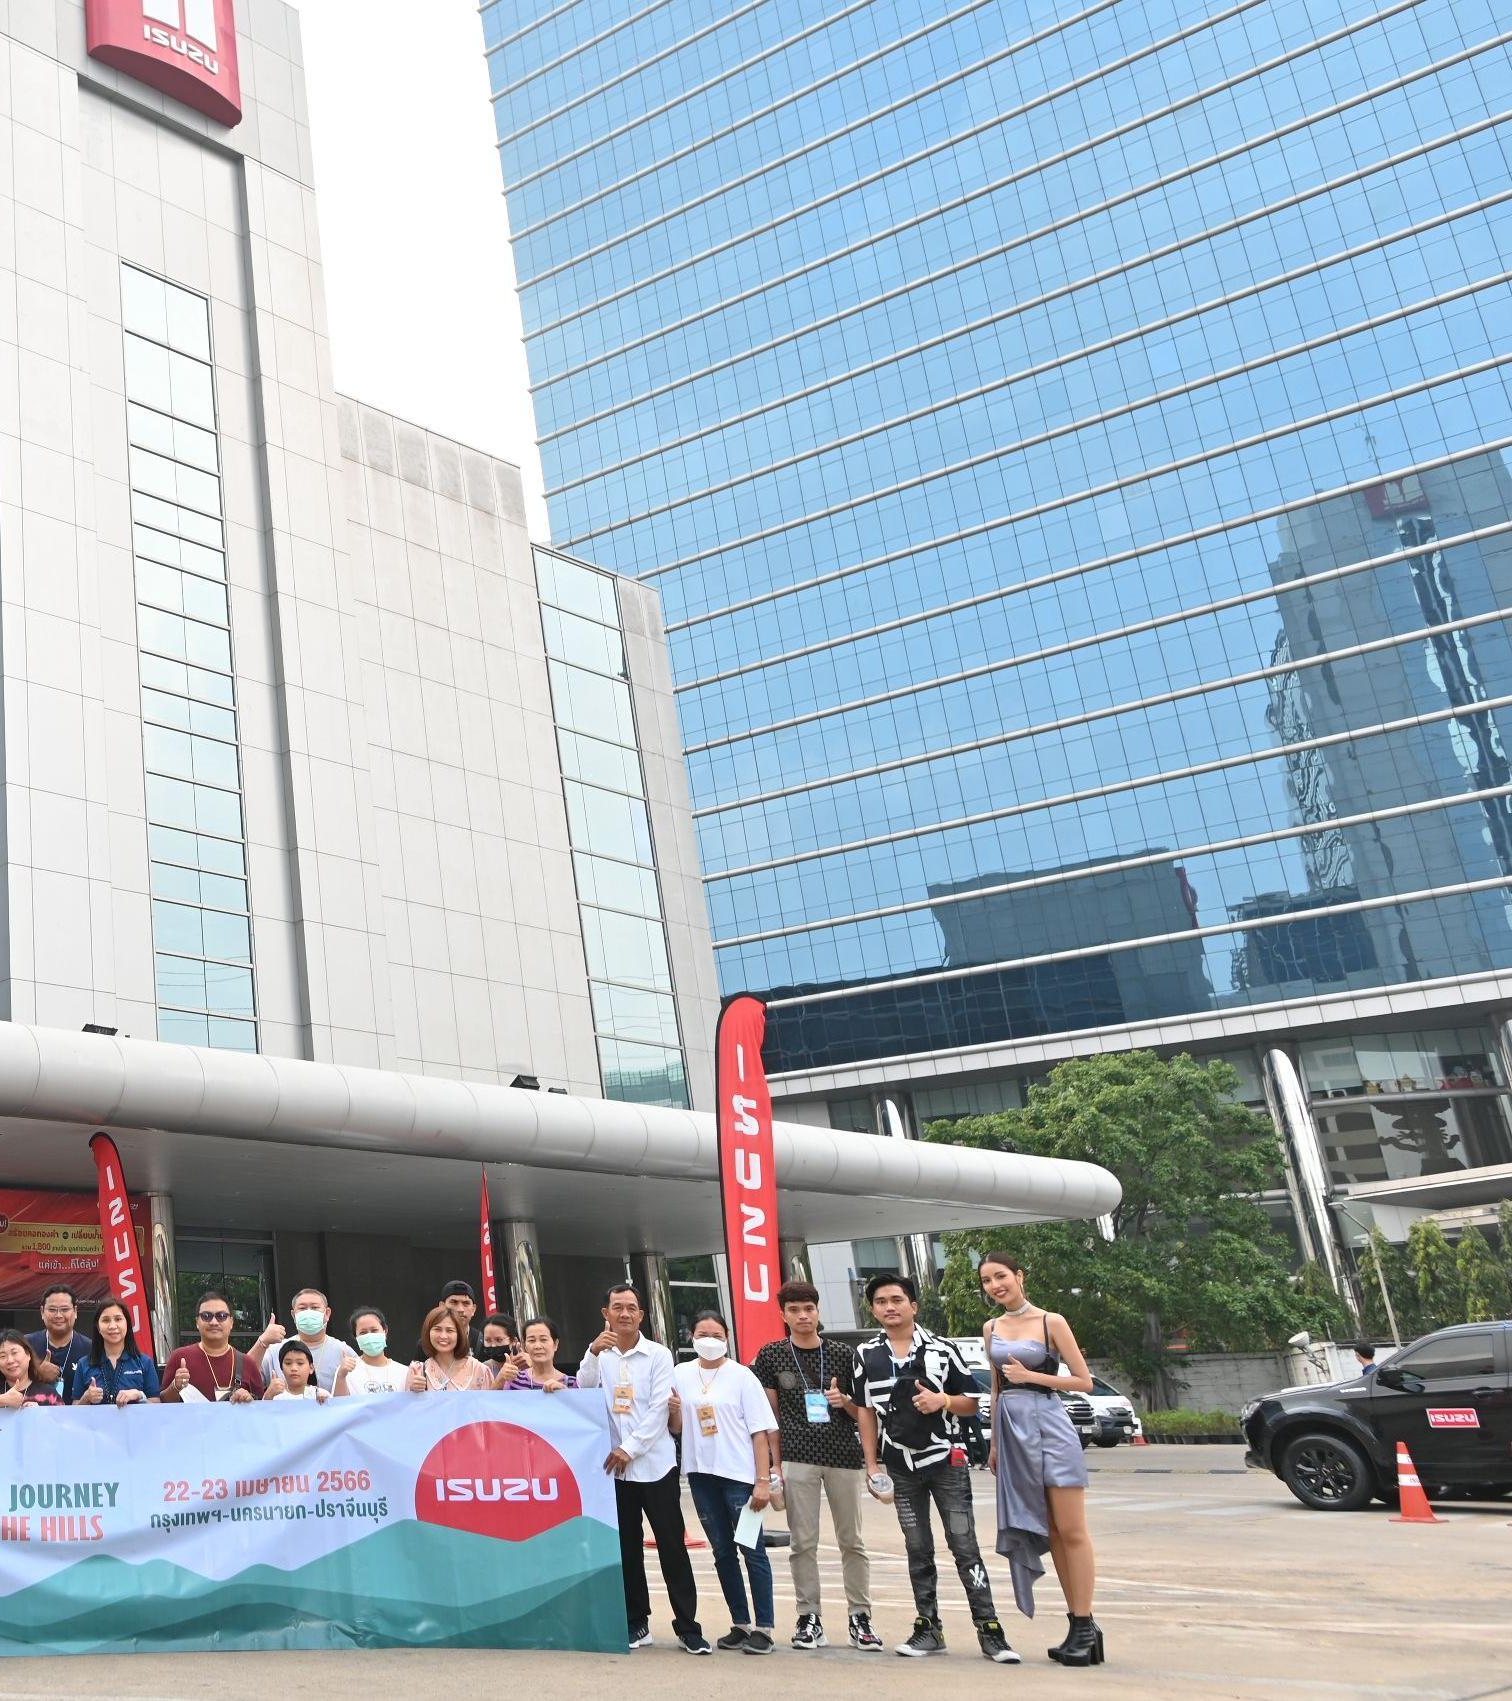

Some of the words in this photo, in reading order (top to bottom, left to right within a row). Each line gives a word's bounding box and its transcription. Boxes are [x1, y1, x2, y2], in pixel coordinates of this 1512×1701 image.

[143, 24, 219, 75] ISUZU
[733, 1044, 769, 1302] ISUZU
[1430, 1413, 1476, 1423] ISUZU
[9, 1481, 120, 1512] JOURNEY
[163, 1478, 229, 1502] 22-23
[235, 1473, 310, 1498] เมษายน
[317, 1469, 371, 1493] 2566
[436, 1477, 560, 1502] ISUZU
[40, 1514, 104, 1541] HILLS
[150, 1496, 388, 1533] กรุงเทพฯ-นครนายก-ปราจีนบุรี
